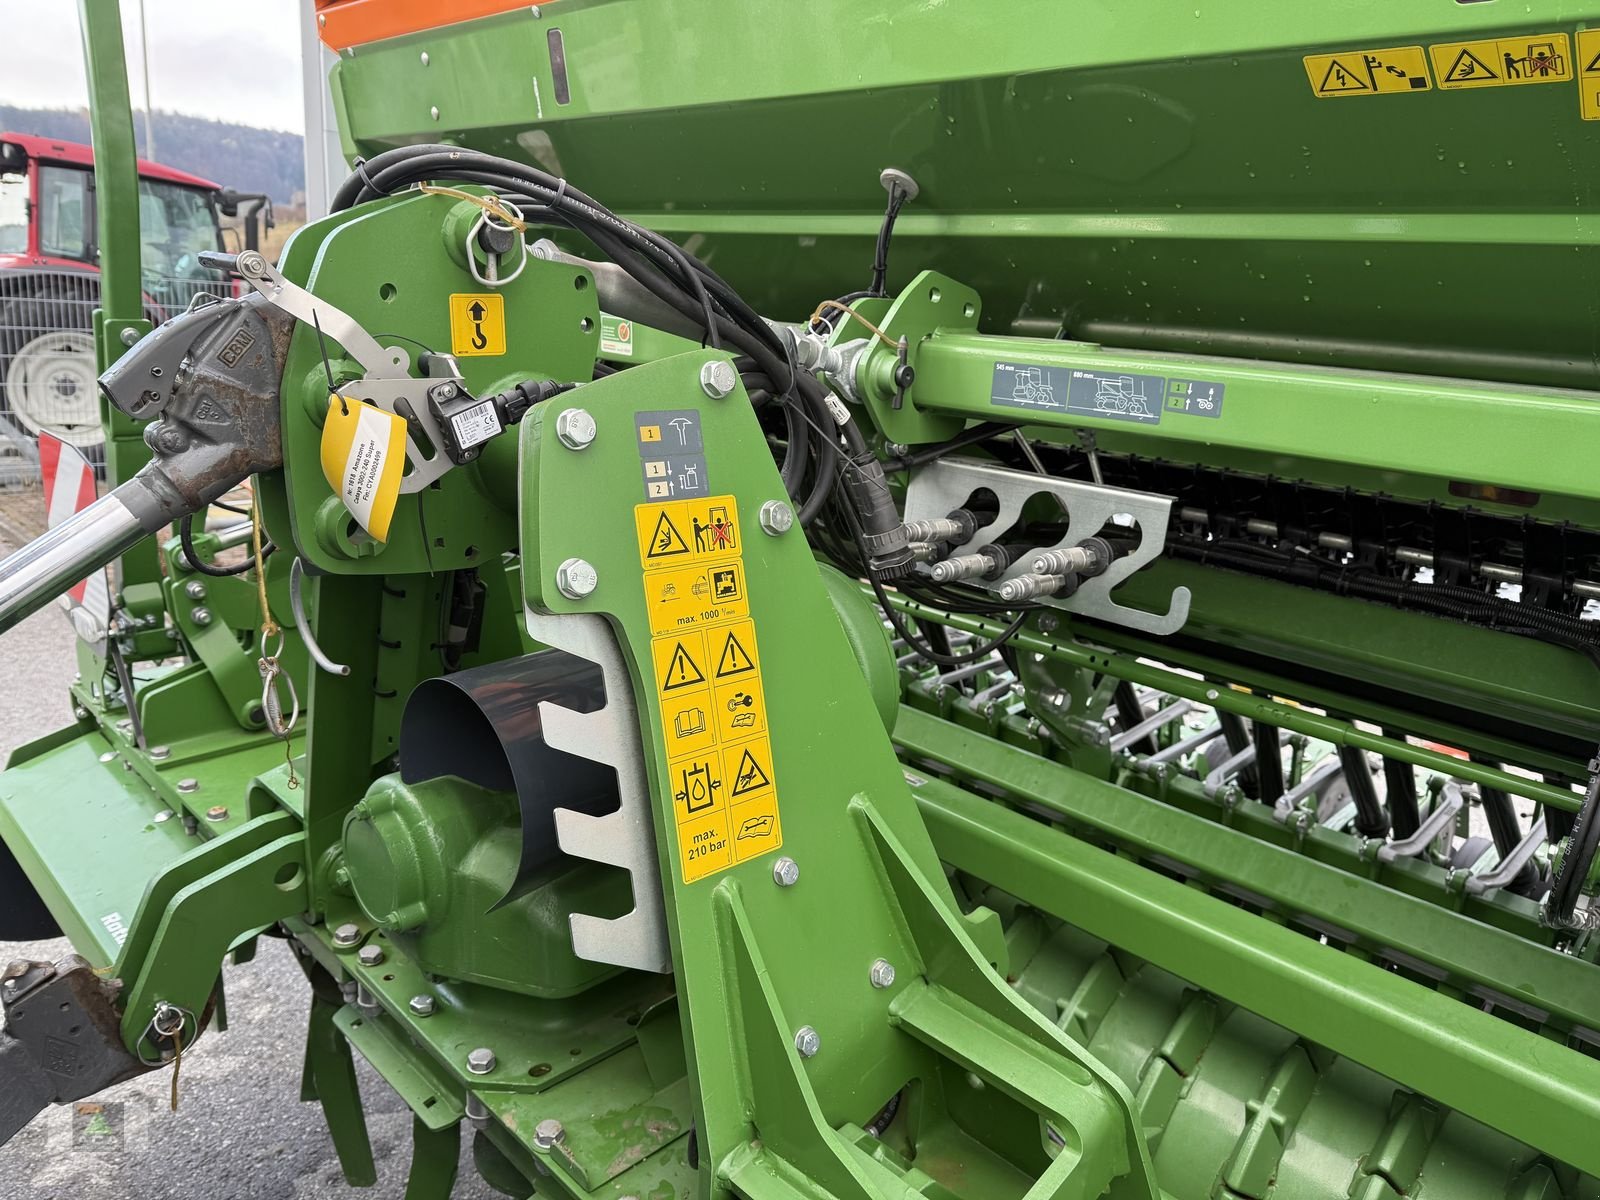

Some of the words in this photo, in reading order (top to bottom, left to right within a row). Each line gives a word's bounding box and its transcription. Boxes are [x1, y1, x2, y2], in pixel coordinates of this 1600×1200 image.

[222, 332, 252, 364] CBM
[1174, 398, 1179, 407] 2
[648, 429, 654, 439] 1
[352, 443, 365, 471] Amazone
[366, 440, 375, 458] Super
[653, 465, 659, 474] 1
[656, 485, 662, 494] 2
[677, 615, 698, 626] max.
[700, 609, 720, 621] 1000
[693, 829, 718, 844] max.
[688, 845, 707, 860] 210
[709, 839, 727, 852] bar
